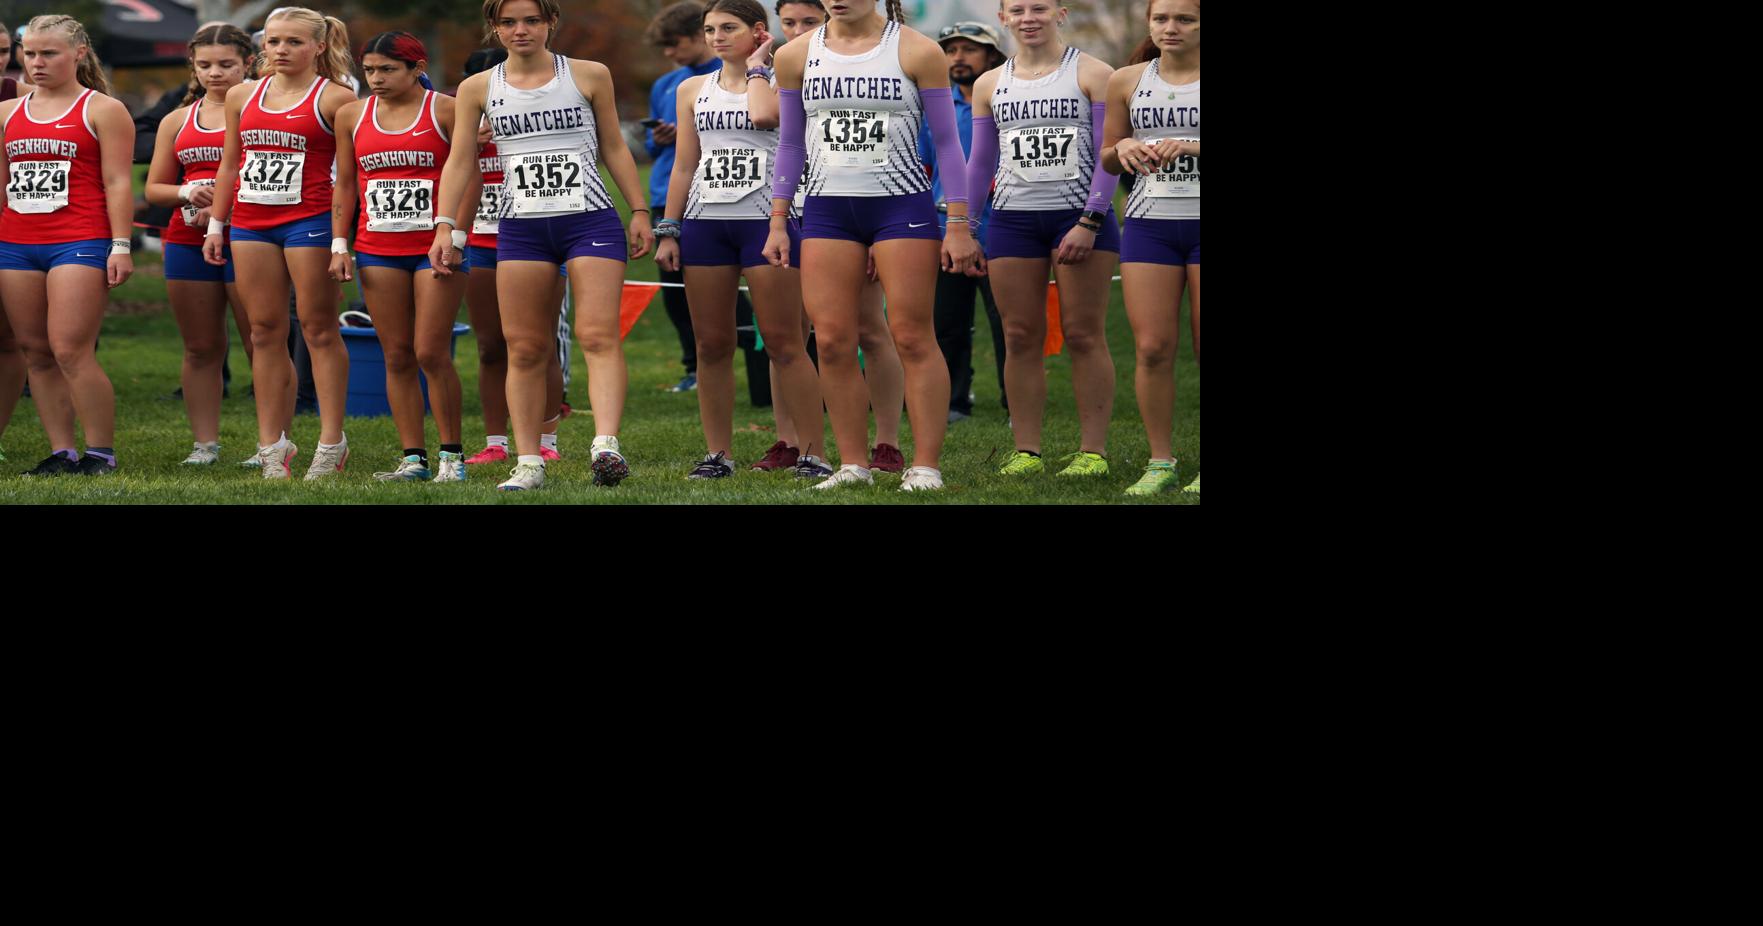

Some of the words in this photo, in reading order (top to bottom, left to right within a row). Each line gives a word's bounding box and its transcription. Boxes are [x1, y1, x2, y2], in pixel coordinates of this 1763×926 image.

[803, 77, 902, 101] WENATCHEE
[830, 110, 850, 118] RUN
[853, 111, 877, 119] FAST
[993, 98, 1079, 123] WENATCHEE
[491, 106, 584, 137] WENATCHEE
[695, 110, 774, 132] ENATCH
[821, 118, 885, 143] 1354
[1042, 127, 1066, 135] FAST
[5, 138, 77, 158] EISENHOWER
[240, 129, 307, 150] EISENHOWER
[843, 144, 875, 152] HAPPY
[1010, 133, 1074, 160] 1357
[18, 162, 36, 170] RUN
[38, 162, 60, 170] FAST
[270, 152, 293, 160] FAST
[358, 150, 435, 172] EISENHOWER
[522, 155, 543, 164] RUN
[545, 154, 569, 163] FAST
[1020, 160, 1032, 168] BE
[1035, 159, 1067, 167] HAPPY
[243, 158, 301, 184] 1327
[514, 162, 581, 190] 1352
[703, 156, 762, 181] 1351
[1156, 174, 1166, 182] BE
[9, 170, 66, 192] 1329
[249, 183, 259, 191] BE
[260, 184, 290, 192] HAPPY
[709, 181, 720, 189] BE
[368, 187, 430, 212] 1328
[525, 190, 536, 198] BE
[539, 189, 572, 198] HAPPY
[375, 211, 387, 219] BE
[393, 211, 421, 219] HAPPY
